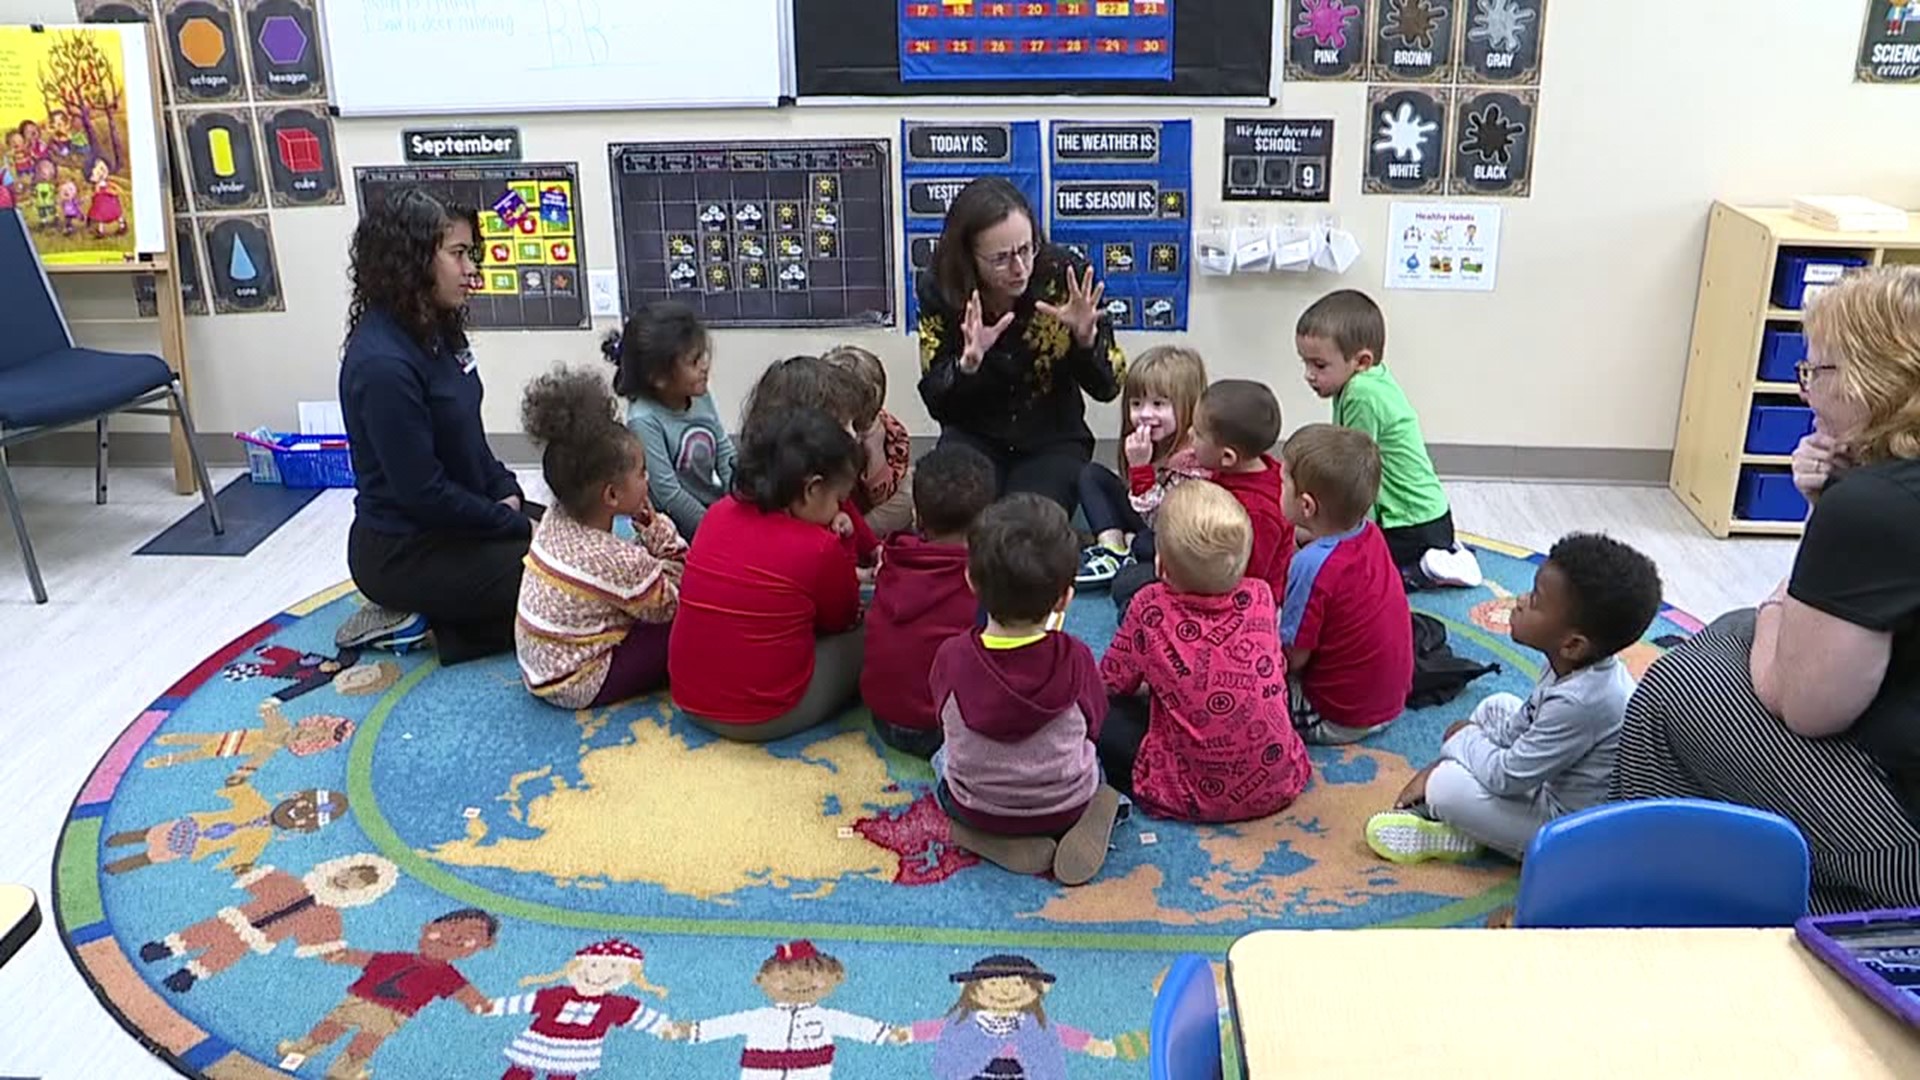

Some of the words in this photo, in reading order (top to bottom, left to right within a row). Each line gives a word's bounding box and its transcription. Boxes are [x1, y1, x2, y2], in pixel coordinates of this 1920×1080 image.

[917, 4, 928, 16] 17
[1028, 4, 1043, 16] 20
[1067, 4, 1079, 15] 21
[1105, 4, 1119, 14] 22
[915, 40, 930, 53] 24
[952, 40, 967, 52] 25
[991, 40, 1005, 53] 26
[1030, 40, 1045, 52] 27
[1067, 40, 1081, 52] 28
[1105, 40, 1119, 52] 29
[1143, 40, 1159, 52] 30
[1871, 43, 1920, 62] SCIENC
[1313, 49, 1340, 64] PINK
[1393, 50, 1432, 65] BROWN
[1486, 53, 1514, 68] GRAY
[189, 74, 228, 87] octagon
[268, 71, 308, 85] hexagon
[1236, 125, 1253, 138] We
[1254, 123, 1281, 137] have
[1282, 123, 1309, 137] been
[1310, 124, 1323, 138] in
[411, 134, 512, 157] September
[929, 136, 970, 152] TODAY
[972, 136, 988, 152] IS:
[1057, 134, 1080, 151] THE
[1081, 134, 1138, 151] WEATHER
[1140, 134, 1156, 151] IS:
[1254, 138, 1302, 152] SCHOOL:
[1302, 166, 1314, 188] 9
[1388, 163, 1421, 178] WHITE
[1473, 164, 1507, 180] BLACK
[209, 181, 245, 195] cylinder
[293, 177, 316, 190] cube
[927, 184, 965, 200] YESTE
[1058, 192, 1083, 209] THE
[1085, 191, 1136, 209] SEASON
[1138, 191, 1155, 209] IS:
[1415, 212, 1447, 222] Healthy
[1448, 213, 1475, 221] Habits
[1163, 640, 1191, 678] THOR
